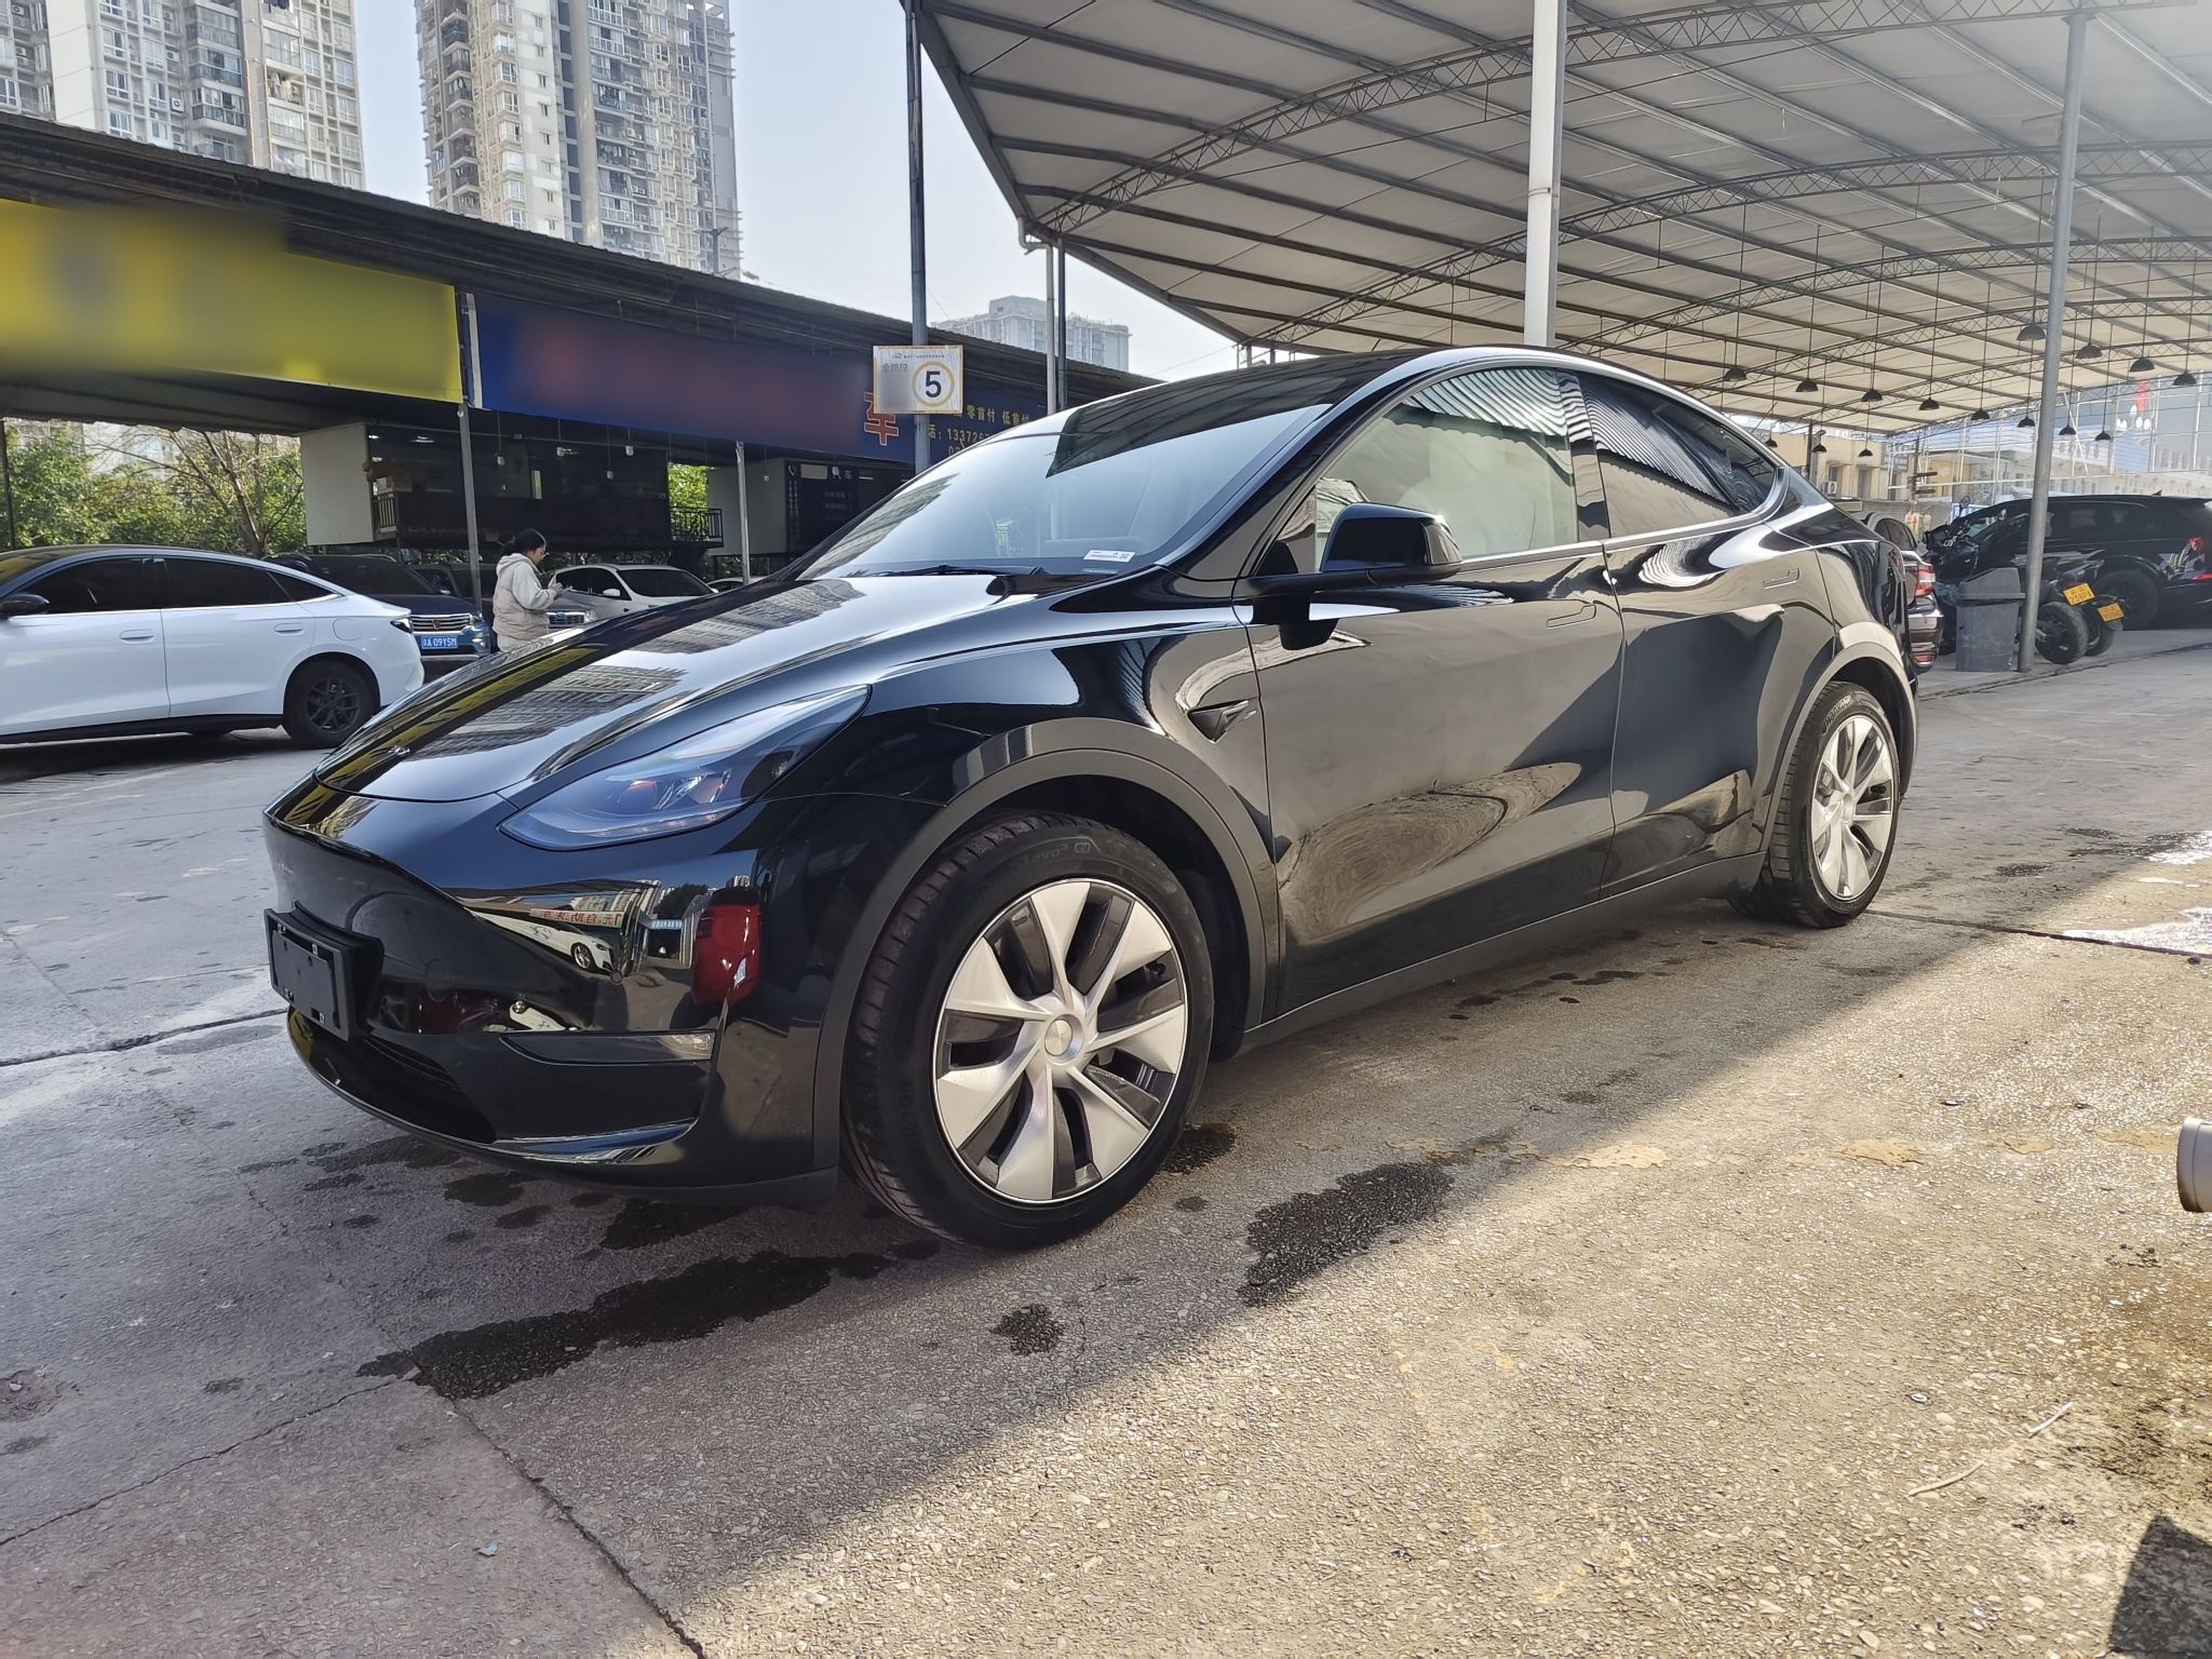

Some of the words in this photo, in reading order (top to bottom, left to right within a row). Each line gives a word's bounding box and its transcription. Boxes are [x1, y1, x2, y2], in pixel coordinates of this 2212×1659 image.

[925, 371, 942, 398] 5
[864, 392, 899, 445] 车
[967, 404, 996, 423] 零首付
